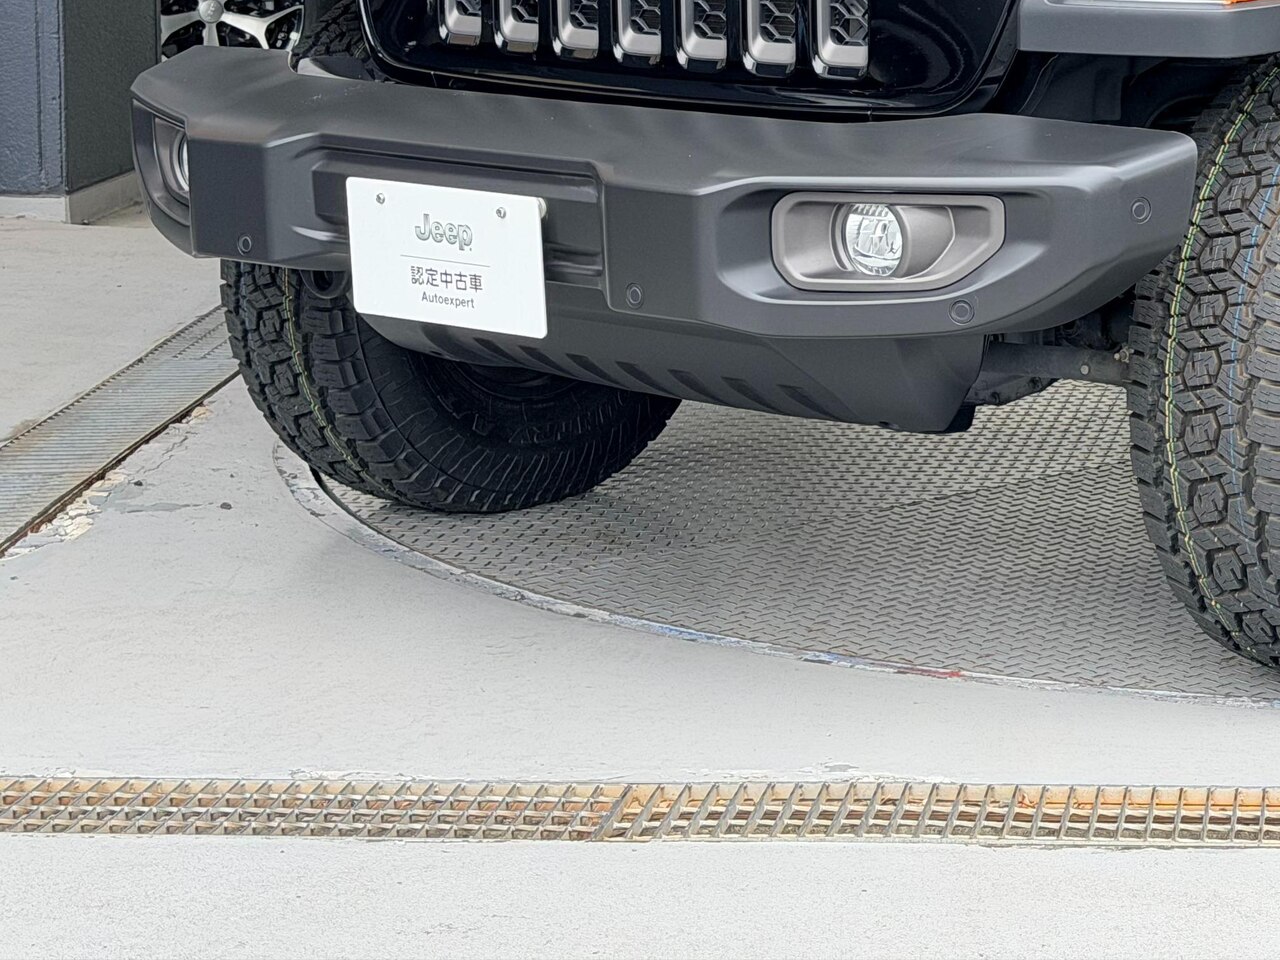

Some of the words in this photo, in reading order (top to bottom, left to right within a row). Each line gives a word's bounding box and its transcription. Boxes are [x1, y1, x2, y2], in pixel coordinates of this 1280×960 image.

[414, 213, 473, 251] Jeep
[410, 265, 483, 293] 認定中古車
[421, 291, 475, 309] Autoexpert
